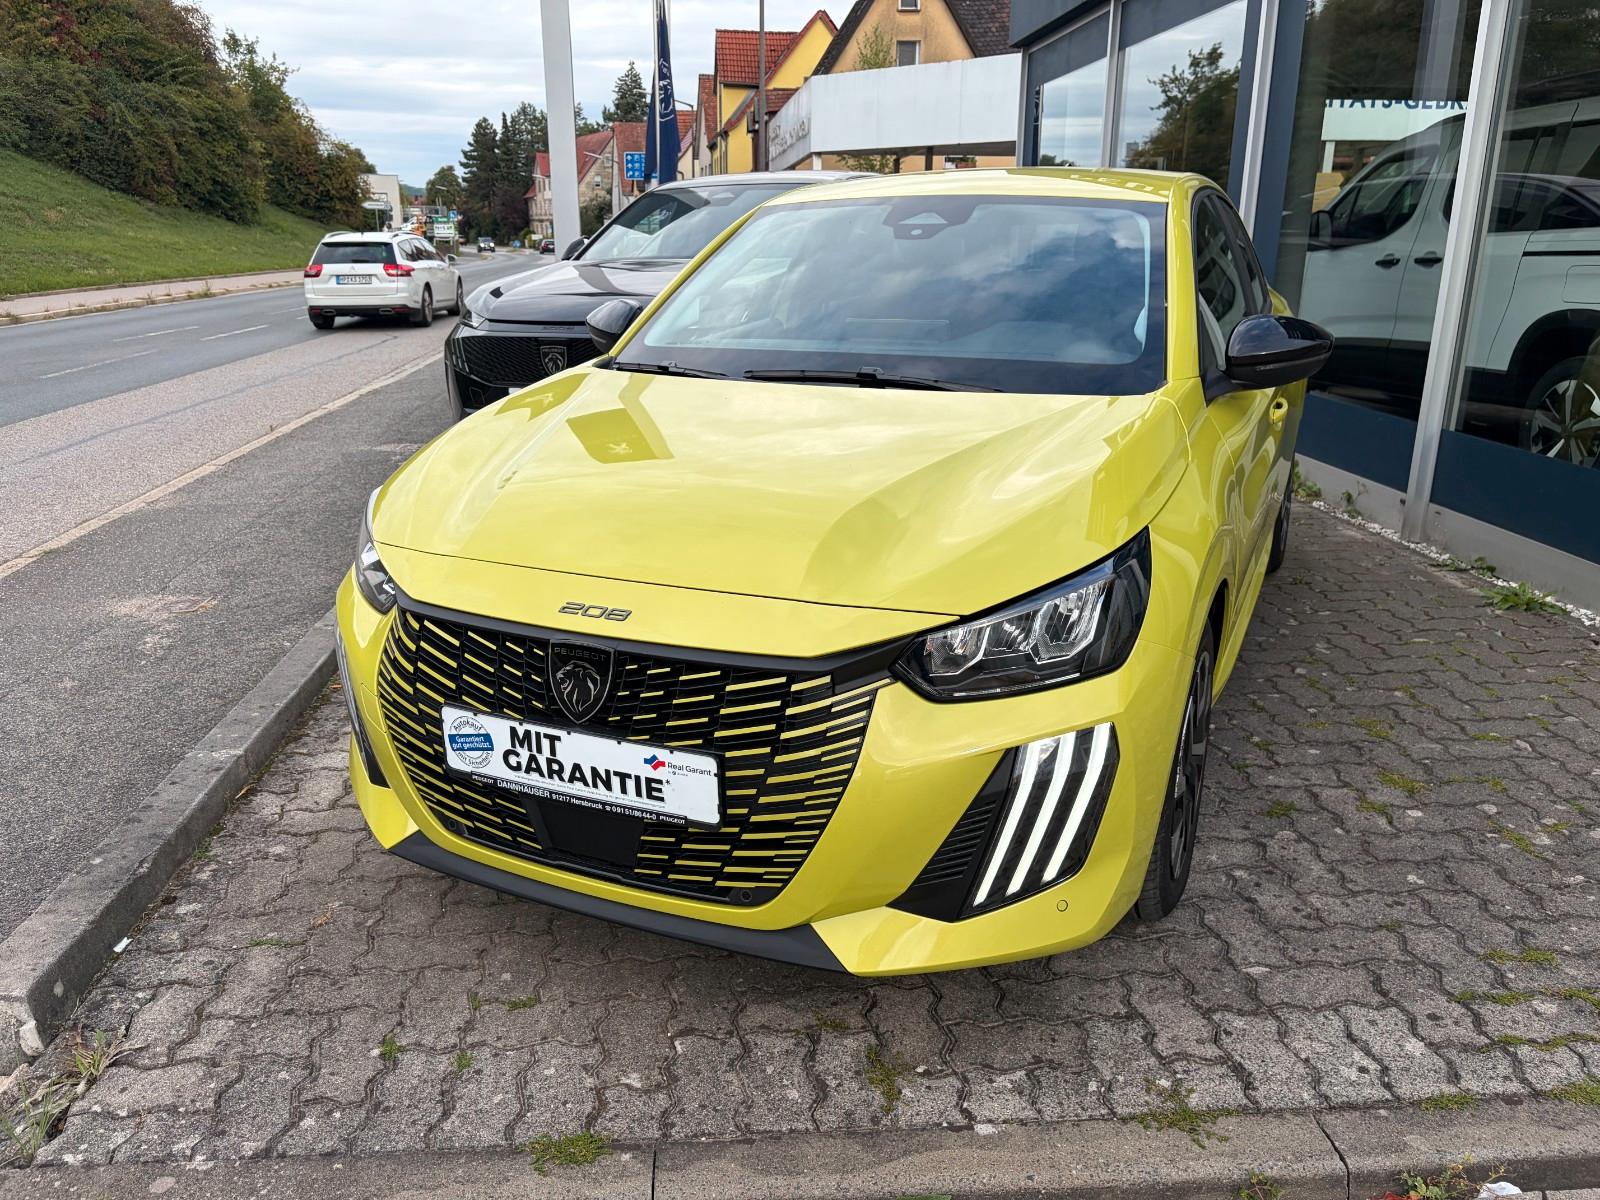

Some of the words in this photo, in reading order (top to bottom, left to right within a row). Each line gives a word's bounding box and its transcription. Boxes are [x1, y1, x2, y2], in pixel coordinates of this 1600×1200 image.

[558, 601, 632, 622] 208
[554, 647, 607, 661] PEUGEOT
[453, 719, 482, 732] Autokauf
[452, 741, 462, 750] gut
[509, 725, 562, 758] MIT
[667, 762, 684, 771] Real
[685, 765, 712, 776] Garant
[472, 775, 494, 784] PEUGEOT
[551, 793, 569, 803] 91217
[570, 797, 603, 810] Hersbruck
[659, 815, 685, 825] PEUGEOT
